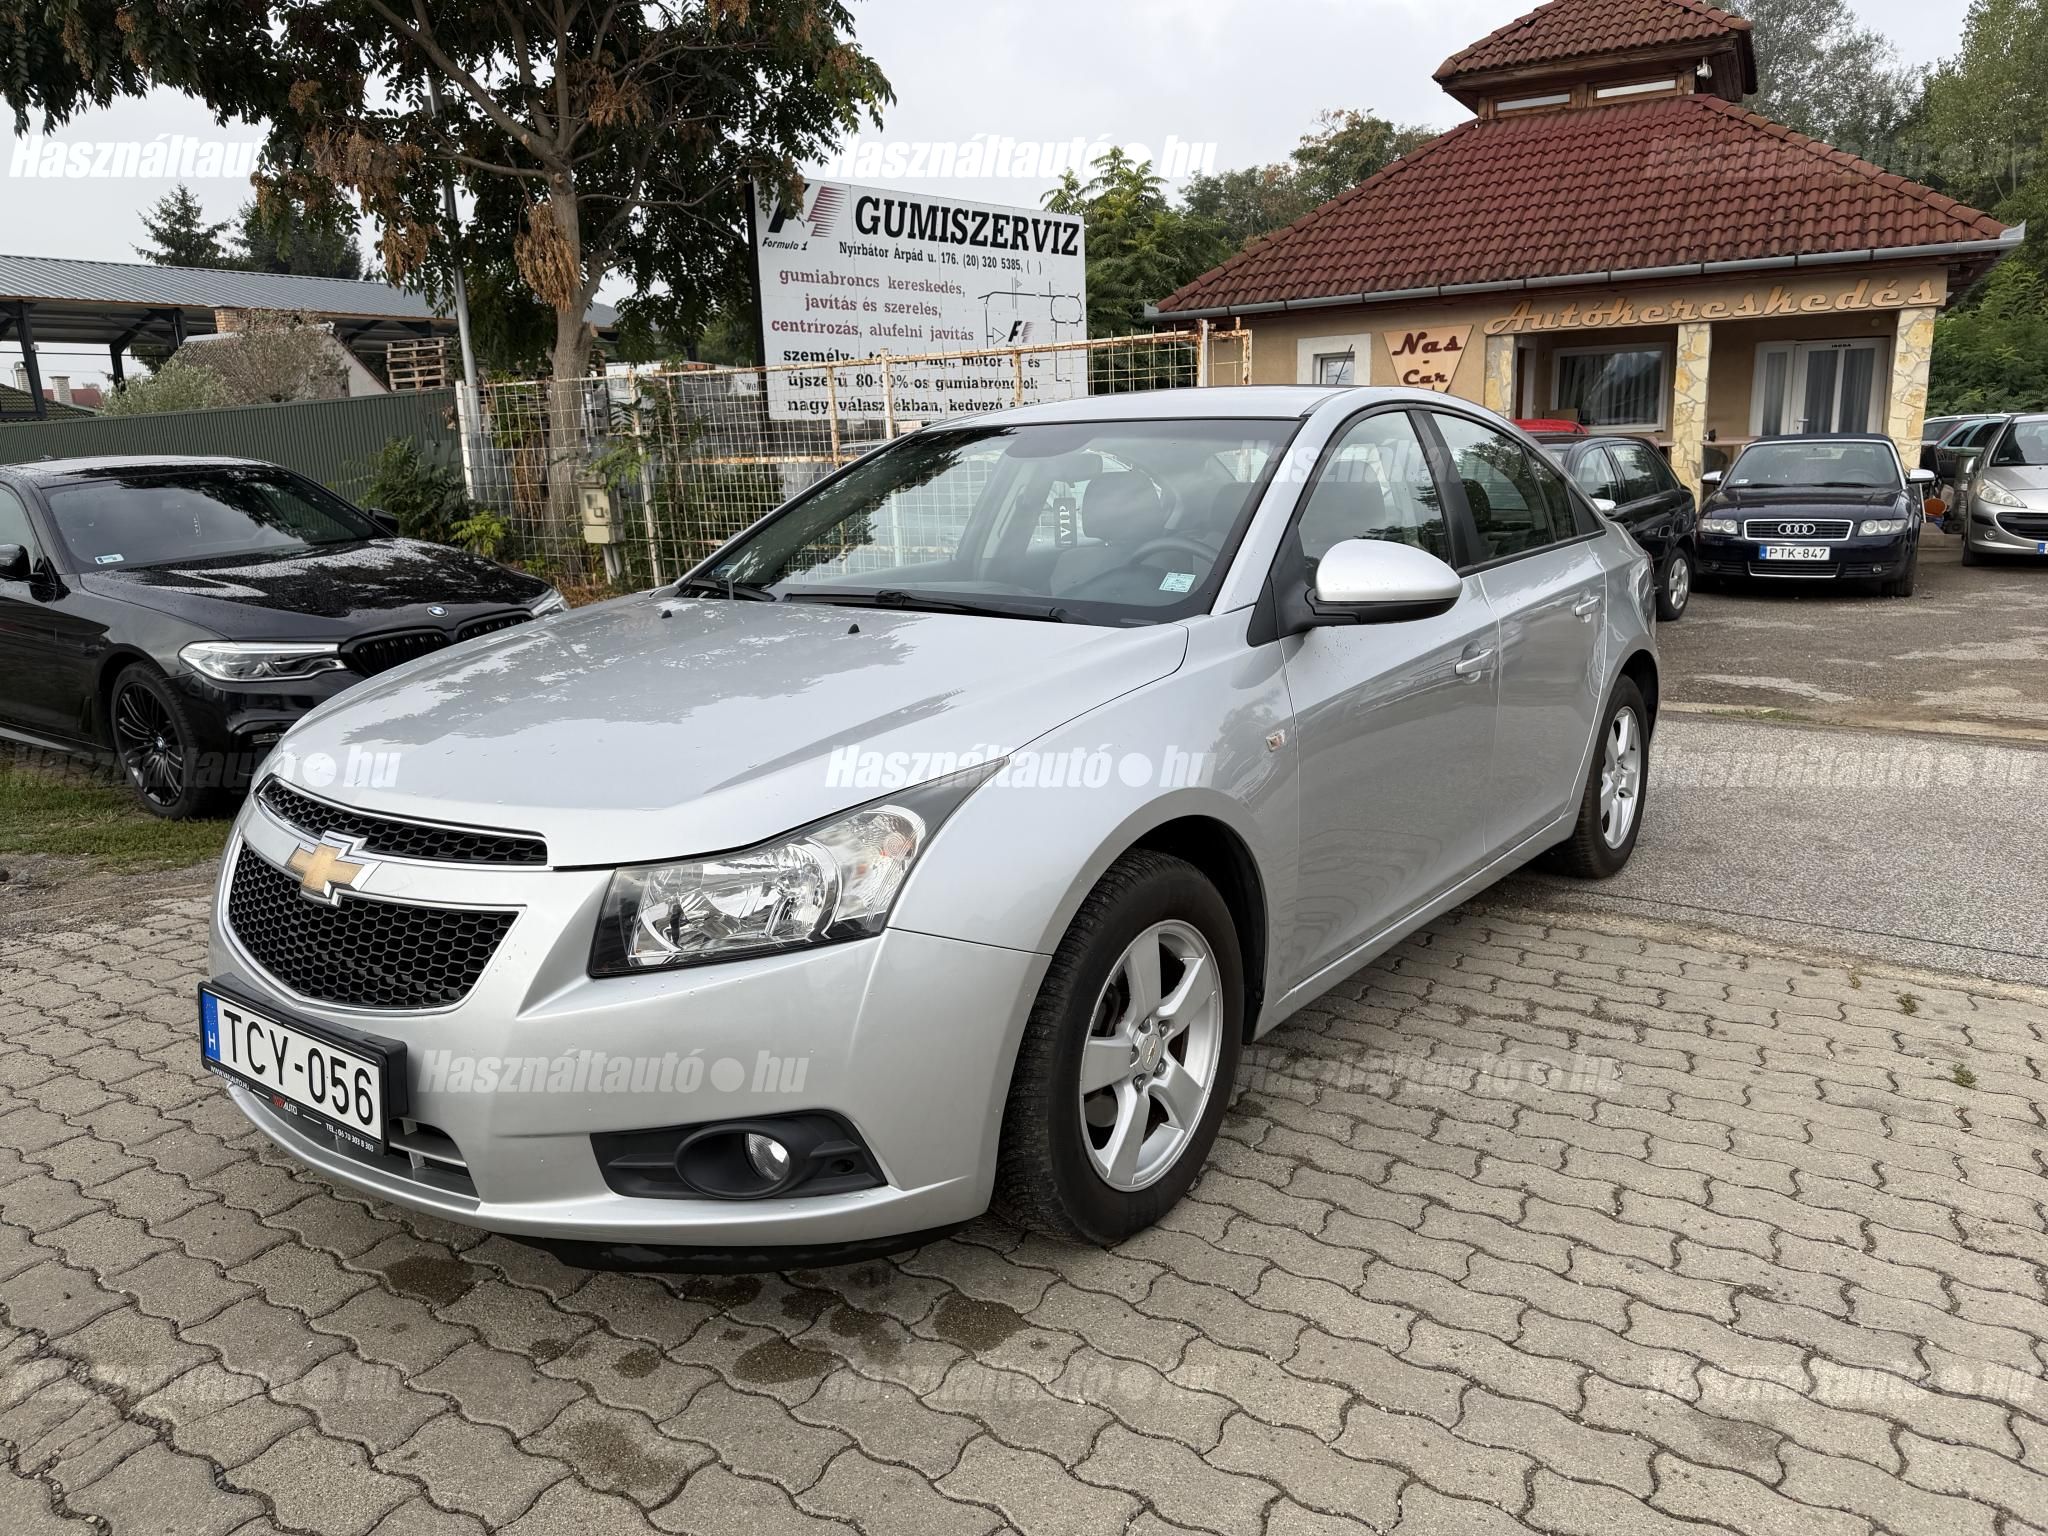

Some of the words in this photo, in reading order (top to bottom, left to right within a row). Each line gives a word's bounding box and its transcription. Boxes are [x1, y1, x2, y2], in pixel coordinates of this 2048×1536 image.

[855, 195, 1080, 257] GUMISZERVIZ
[762, 237, 799, 250] Formula
[839, 241, 889, 258] Nyírbátor
[894, 243, 923, 263] Árpád
[927, 252, 937, 263] u.
[941, 252, 959, 265] 176.
[963, 253, 980, 270] (20)
[982, 256, 997, 269] 320
[779, 269, 880, 288] gumiabroncs
[888, 276, 966, 297] kereskedés,
[804, 293, 857, 311] javítás
[862, 296, 878, 312] és
[884, 301, 942, 318] szerelés,
[1483, 279, 1940, 334] Autókereskedés
[771, 318, 863, 338] centrírozás,
[869, 323, 923, 338] alufelni
[930, 326, 974, 342] javítás
[1392, 331, 1463, 356] Nas
[962, 356, 1002, 368] motor
[1028, 355, 1040, 368] és
[787, 371, 848, 388] újszeű
[1403, 369, 1448, 385] Car
[787, 399, 829, 414] nagy
[838, 396, 943, 413] válaszékban,
[1768, 547, 1827, 559] PTK-847
[208, 1030, 216, 1046] H
[223, 1009, 374, 1126] TCY-056
